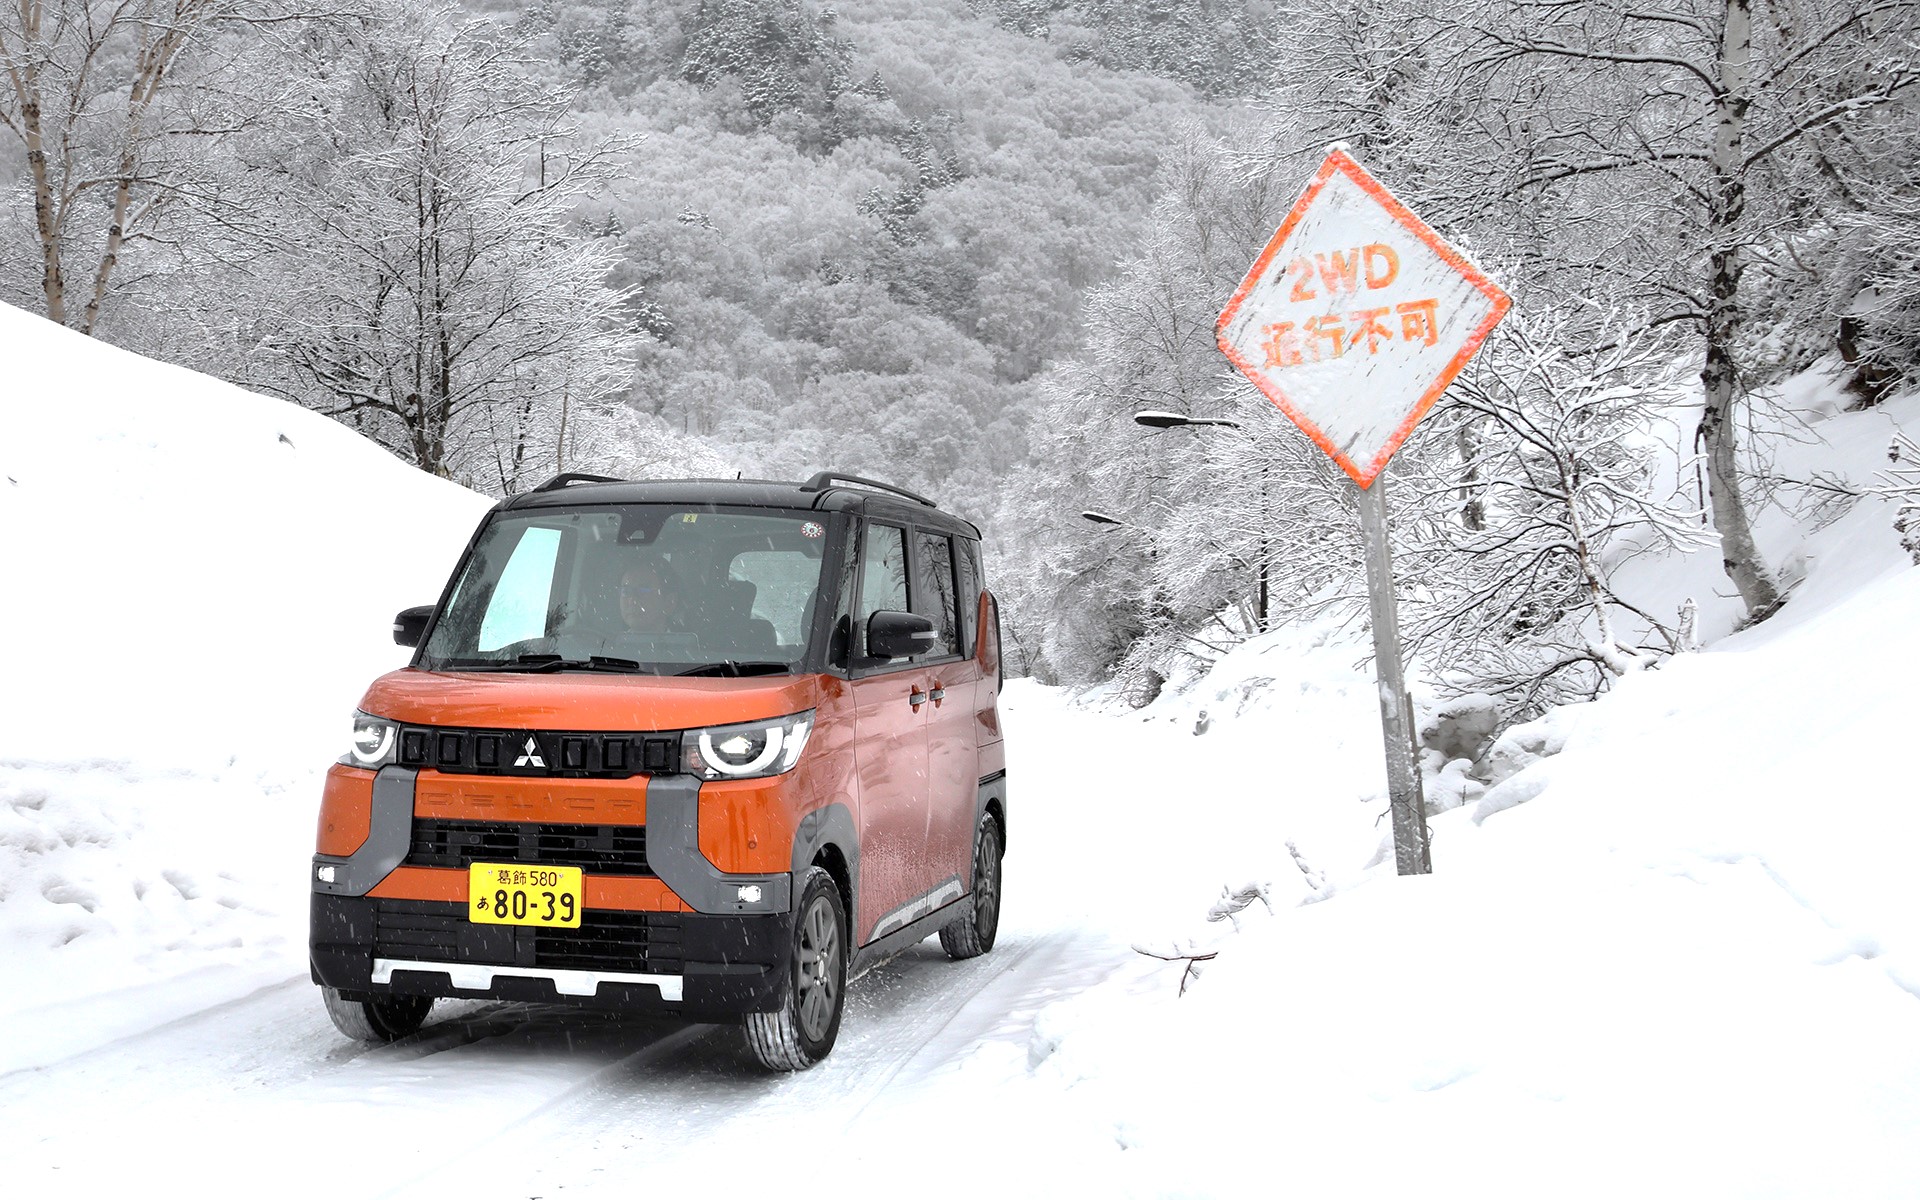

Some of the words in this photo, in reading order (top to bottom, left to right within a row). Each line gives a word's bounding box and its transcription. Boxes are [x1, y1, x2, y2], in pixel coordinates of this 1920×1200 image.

[1287, 244, 1400, 303] 2WD
[477, 896, 489, 911] あ
[494, 889, 575, 923] 80-39
